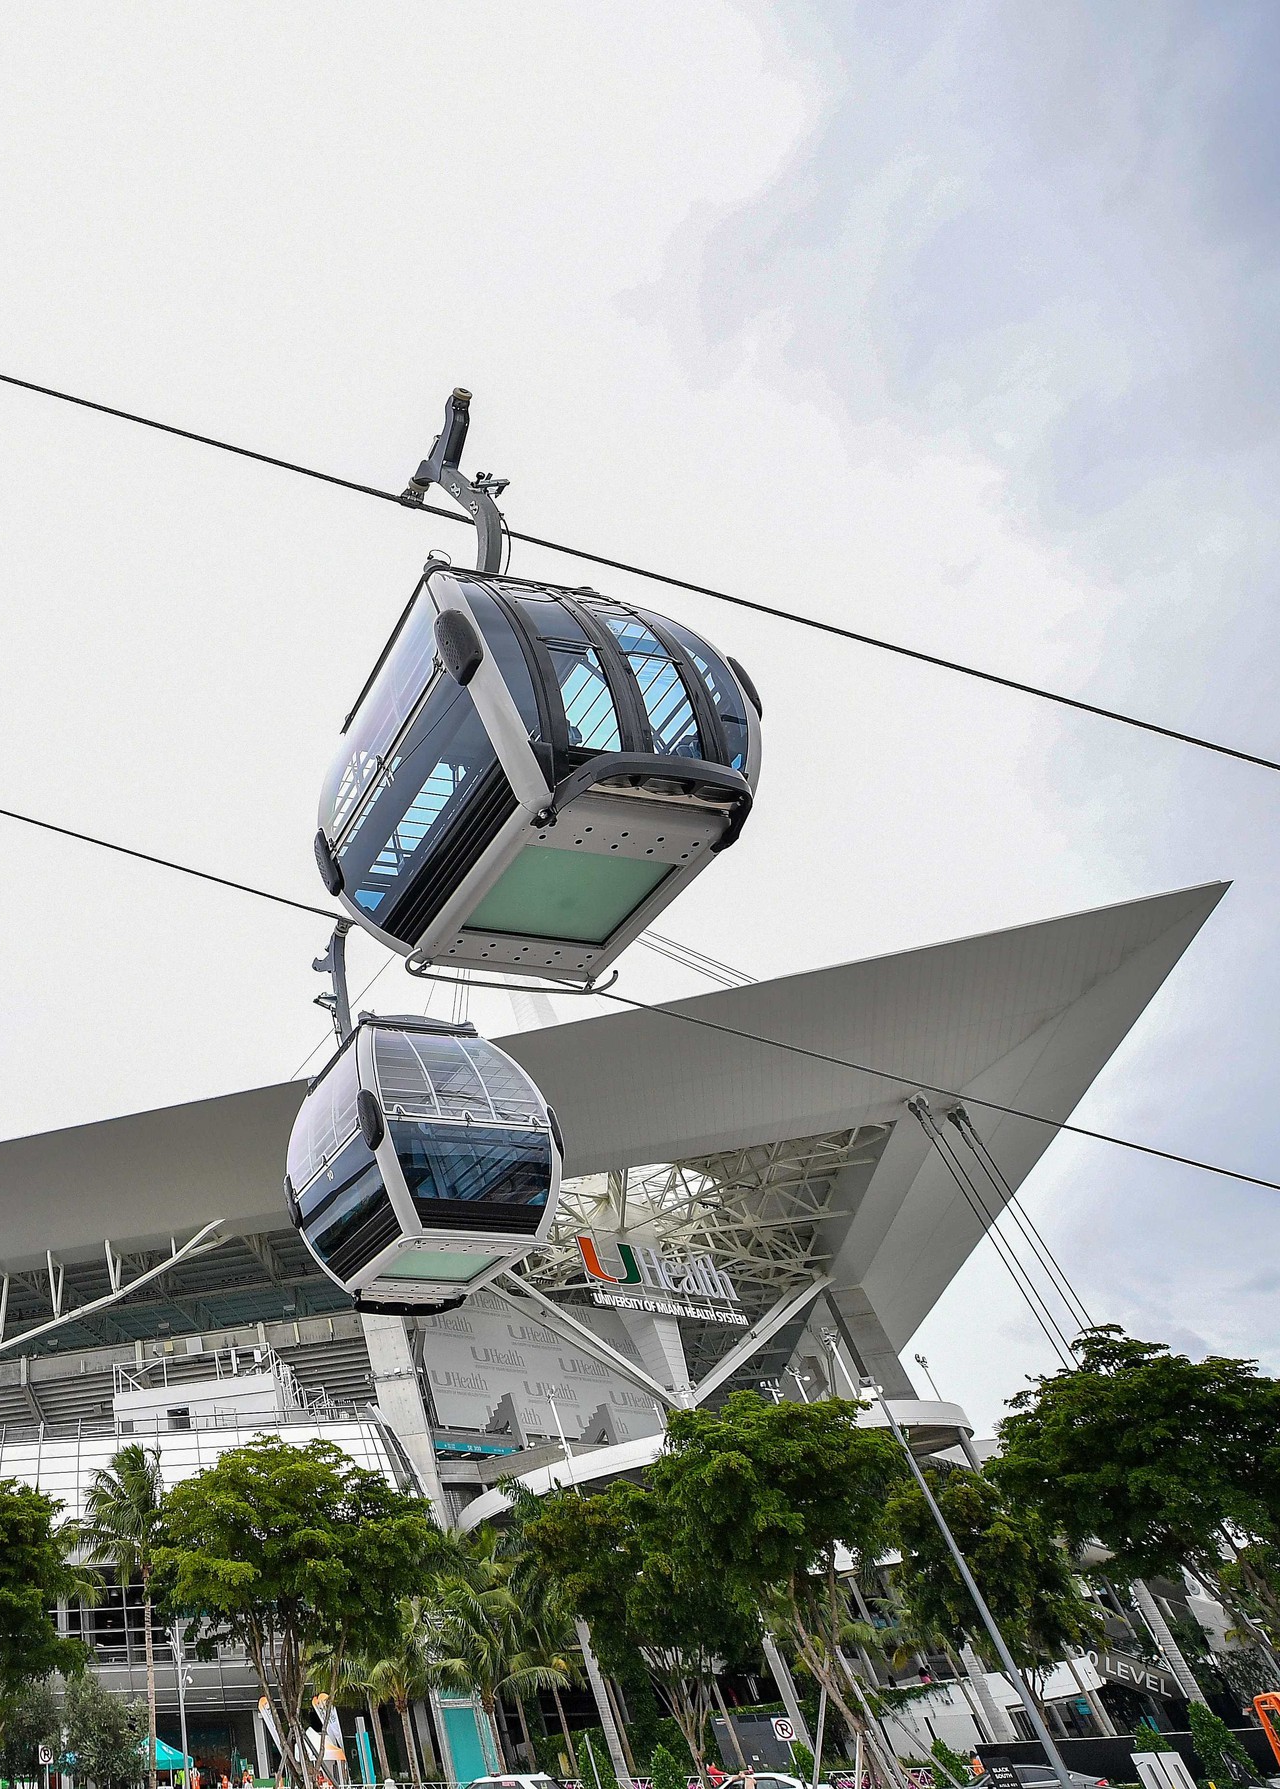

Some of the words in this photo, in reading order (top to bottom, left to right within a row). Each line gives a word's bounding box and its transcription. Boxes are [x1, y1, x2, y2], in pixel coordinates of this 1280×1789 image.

[576, 1235, 741, 1302] UHealth
[593, 1292, 644, 1311] UNIVERSITY
[644, 1299, 656, 1312] OF
[656, 1302, 685, 1317] MIAMI
[684, 1306, 717, 1321] HEALTH
[716, 1311, 749, 1326] SYSTEM
[507, 1324, 559, 1345] UHealth
[470, 1346, 525, 1367] UHealth
[558, 1358, 610, 1377] UHealth
[431, 1370, 489, 1391] UHealth
[522, 1380, 578, 1401] UHalth
[1105, 1656, 1172, 1698] LEVEL
